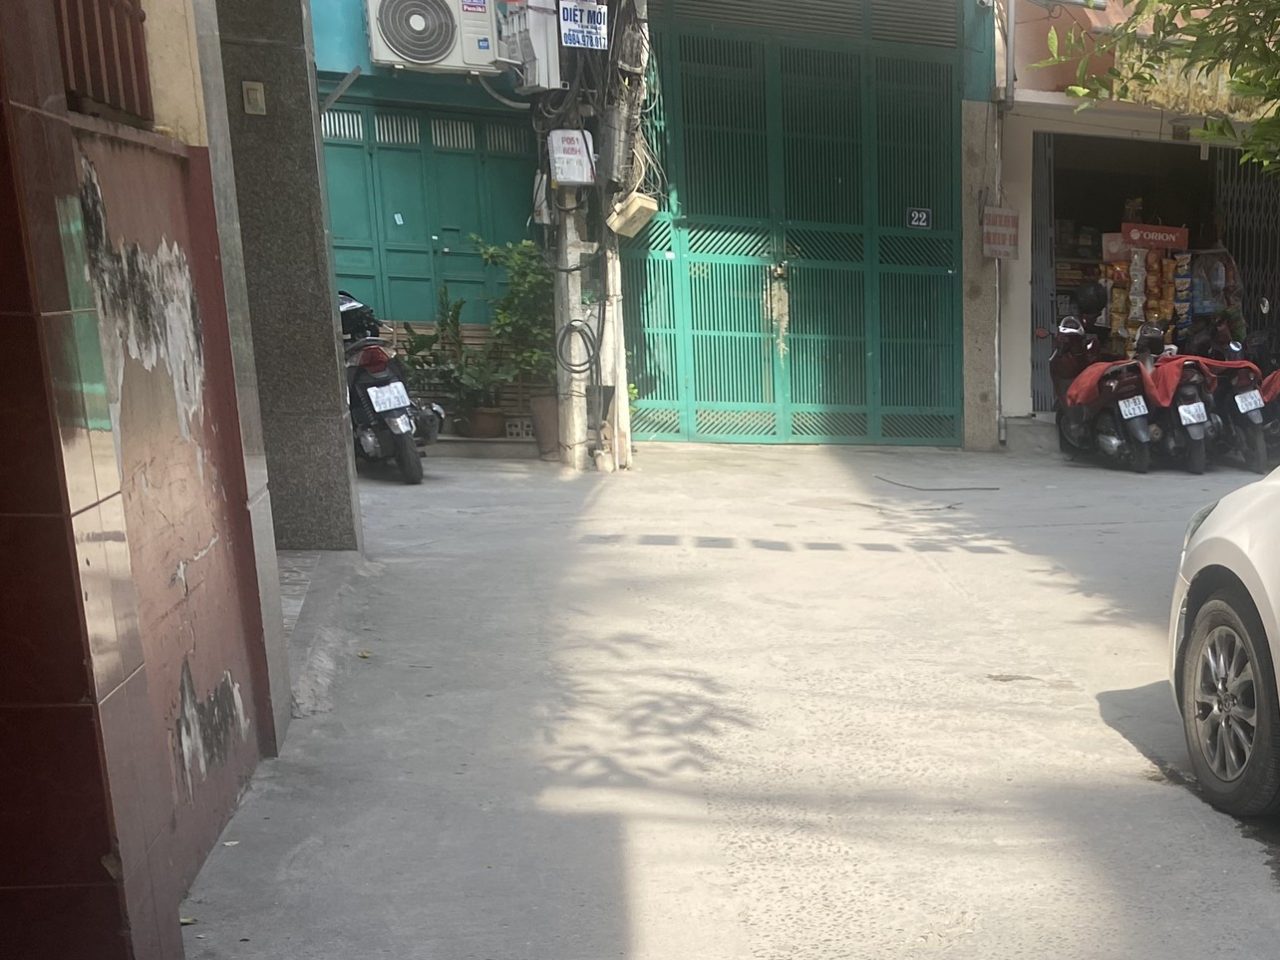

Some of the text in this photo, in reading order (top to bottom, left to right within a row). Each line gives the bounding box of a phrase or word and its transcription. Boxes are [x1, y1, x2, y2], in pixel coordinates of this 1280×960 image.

[562, 5, 606, 26] DIỆT MỐI
[911, 211, 927, 226] 22
[1143, 231, 1176, 242] ORION
